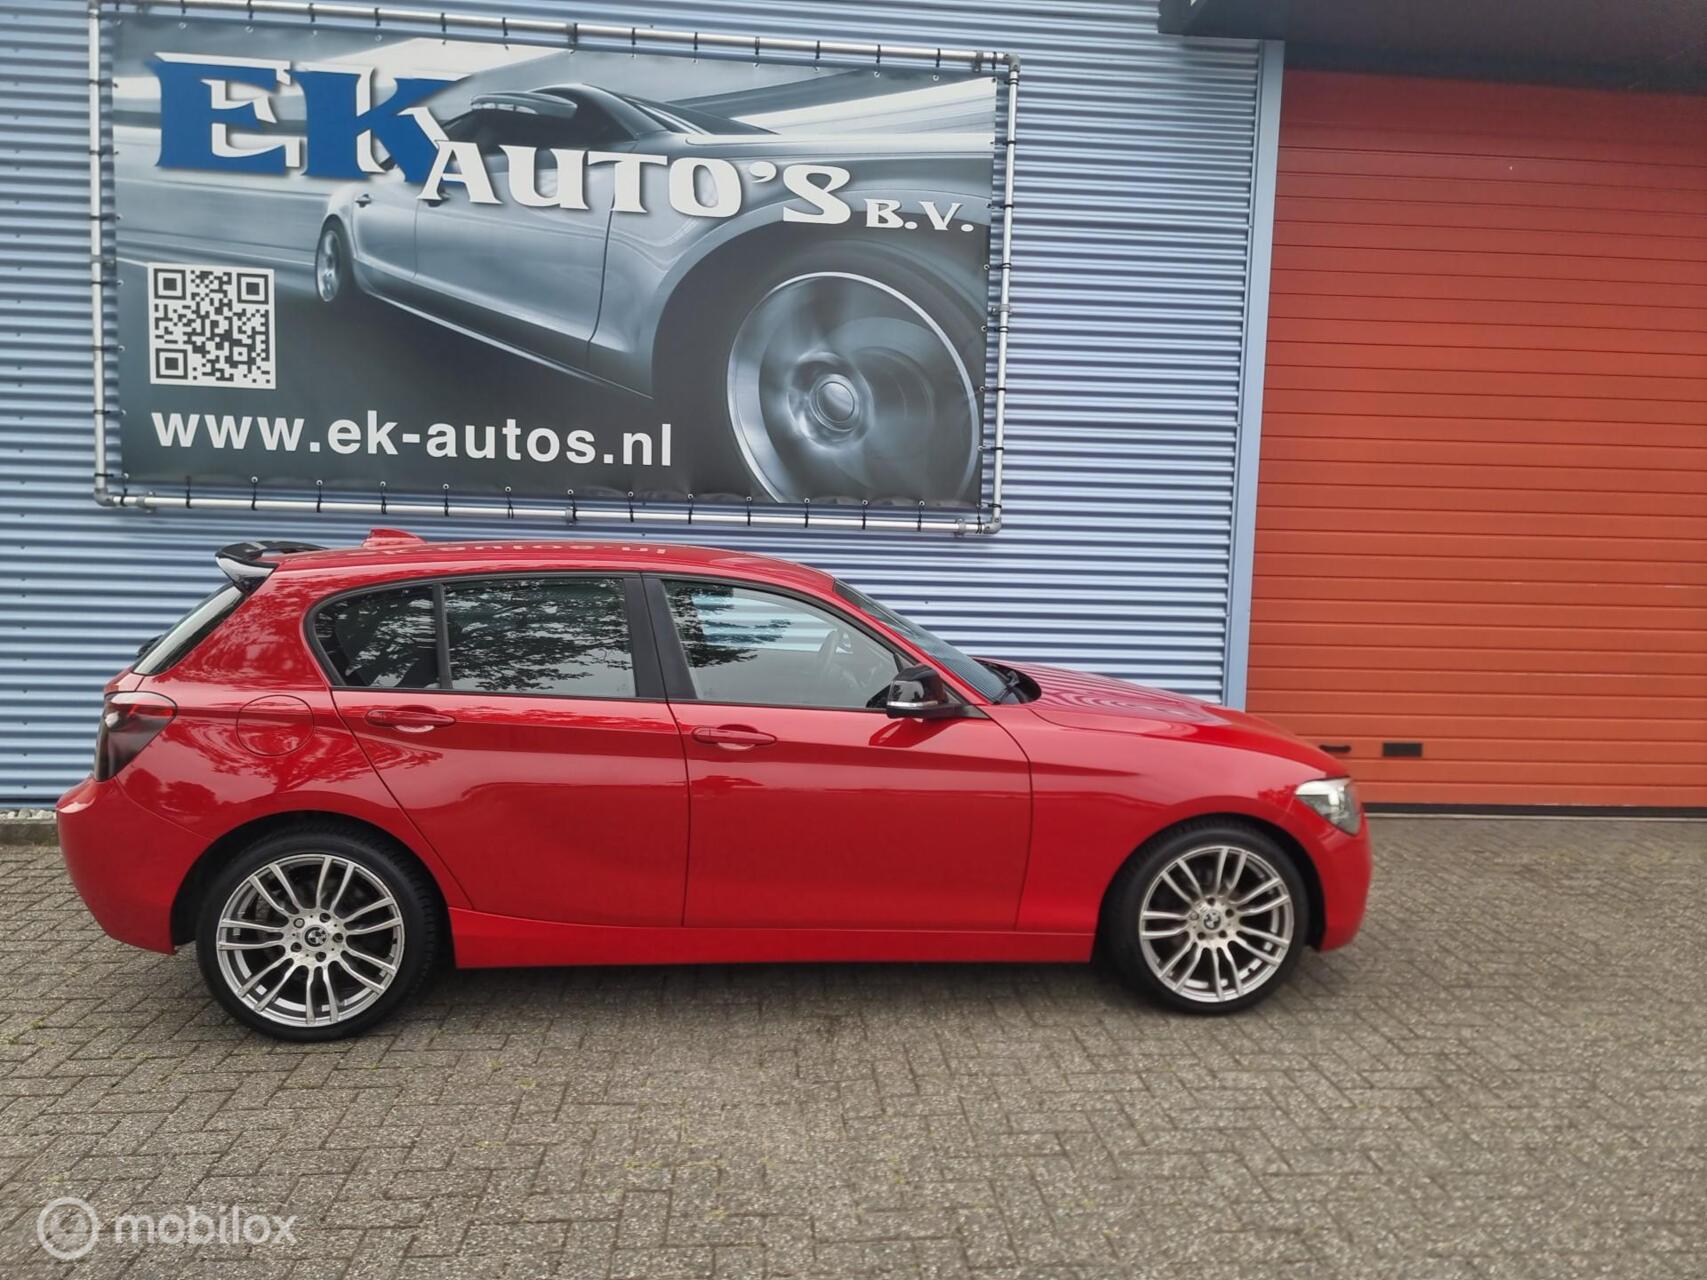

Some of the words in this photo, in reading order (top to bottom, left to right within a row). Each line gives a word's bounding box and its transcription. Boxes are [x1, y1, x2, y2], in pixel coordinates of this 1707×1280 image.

[146, 52, 468, 187] EK
[865, 198, 974, 232] B.V.
[151, 409, 673, 466] www.ek-autos.nl
